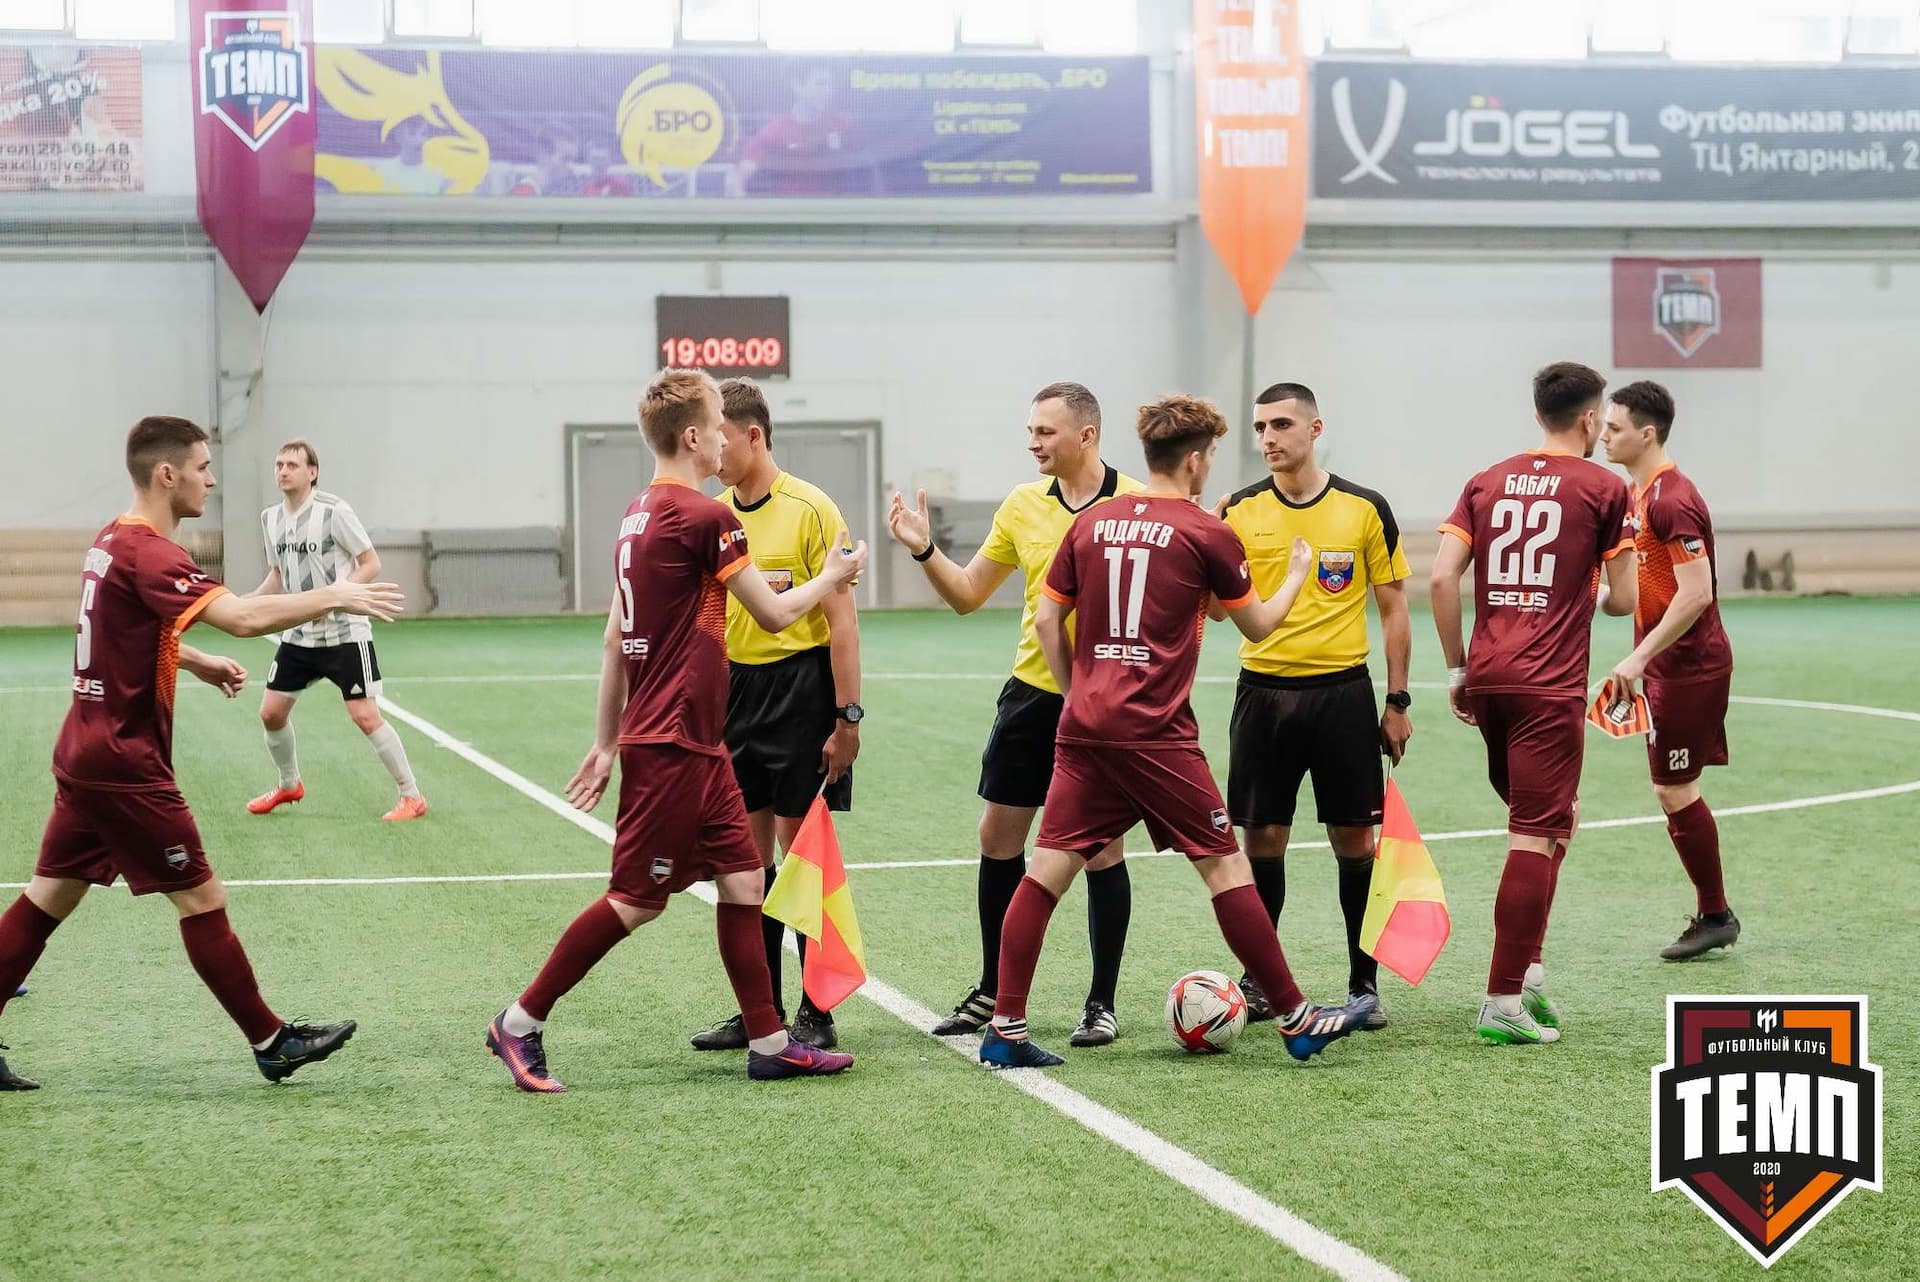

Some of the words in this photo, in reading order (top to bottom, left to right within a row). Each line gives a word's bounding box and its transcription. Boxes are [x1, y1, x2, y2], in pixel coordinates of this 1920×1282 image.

[47, 70, 107, 105] 20%
[210, 49, 298, 98] ТЕМП
[647, 109, 712, 133] .БРО
[1659, 103, 1846, 139] Футбольная
[1690, 142, 1734, 177] ТЦ
[1738, 141, 1896, 177] Янтарный,
[1660, 291, 1713, 324] ТЕМП
[661, 337, 781, 367] 19:08:09
[1504, 473, 1562, 496] БАБИЧ
[1093, 519, 1175, 548] РОДИЧЕВ
[1487, 498, 1563, 587] 22
[1104, 546, 1151, 639] 11
[1488, 590, 1549, 607] SEUS
[1669, 748, 1690, 771] 23
